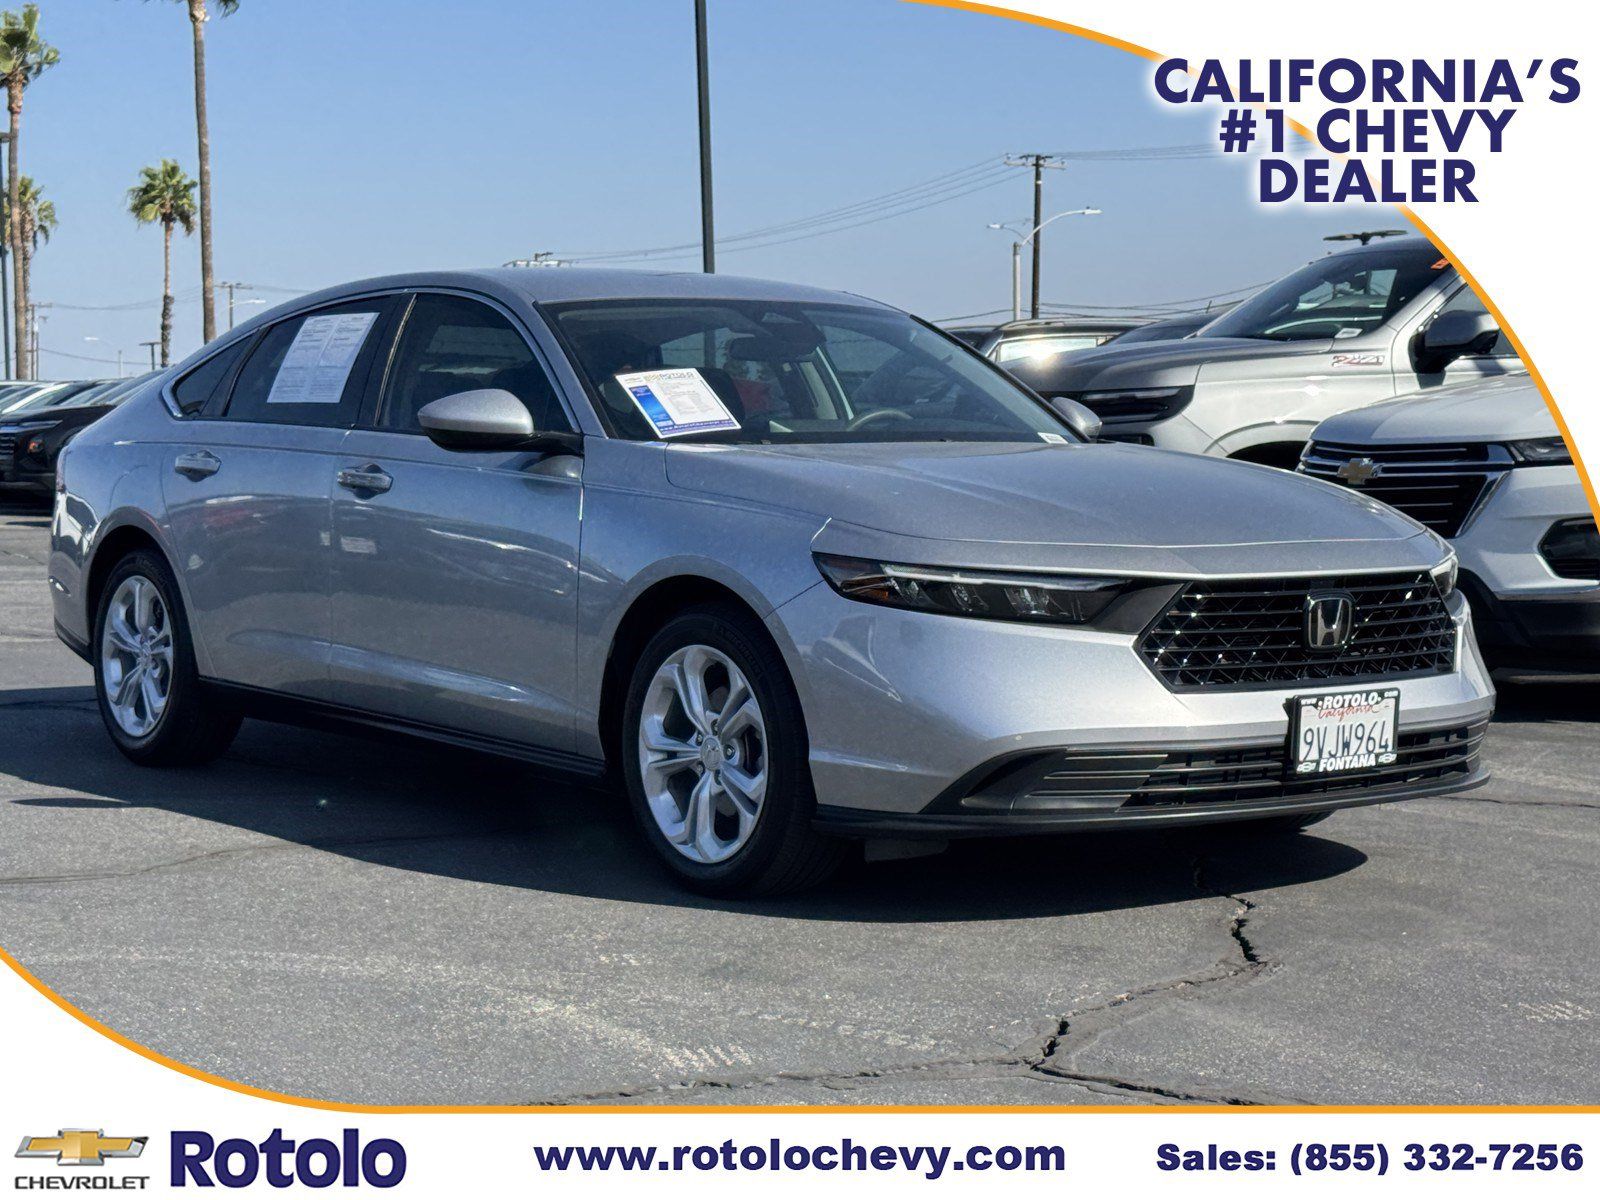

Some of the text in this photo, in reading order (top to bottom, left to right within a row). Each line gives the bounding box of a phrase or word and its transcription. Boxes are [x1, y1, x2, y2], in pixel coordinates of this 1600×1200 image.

[1323, 691, 1378, 709] ROTOLO
[1303, 720, 1388, 762] 9VJW964
[1319, 753, 1377, 772] FONTANA
